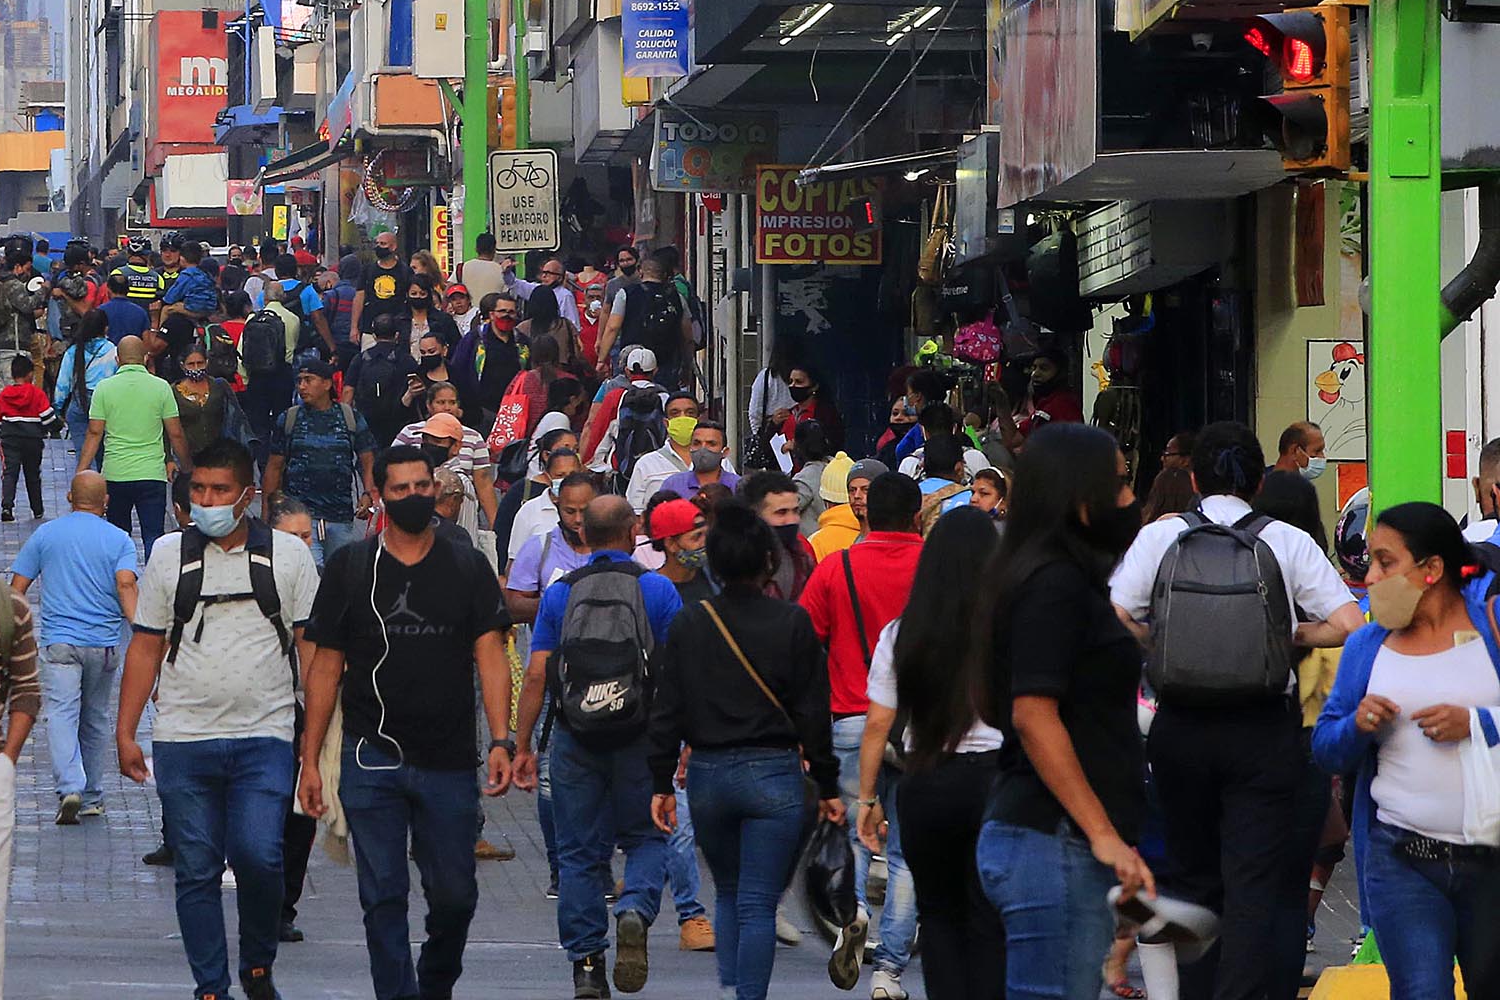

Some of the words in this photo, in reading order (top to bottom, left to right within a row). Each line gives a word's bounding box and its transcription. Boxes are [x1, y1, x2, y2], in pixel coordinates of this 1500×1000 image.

[631, 2, 680, 12] 8692-1552
[638, 29, 675, 38] CALIDAD
[635, 39, 678, 49] SOLUCIÓN
[635, 49, 678, 59] GARANTÍA
[661, 121, 739, 142] TODO
[512, 195, 535, 209] USE
[499, 212, 550, 226] SEMAFORO
[500, 229, 550, 243] PEATONAL
[764, 232, 873, 257] FOTOS
[586, 682, 620, 704] NIKE
[608, 697, 625, 713] SB
